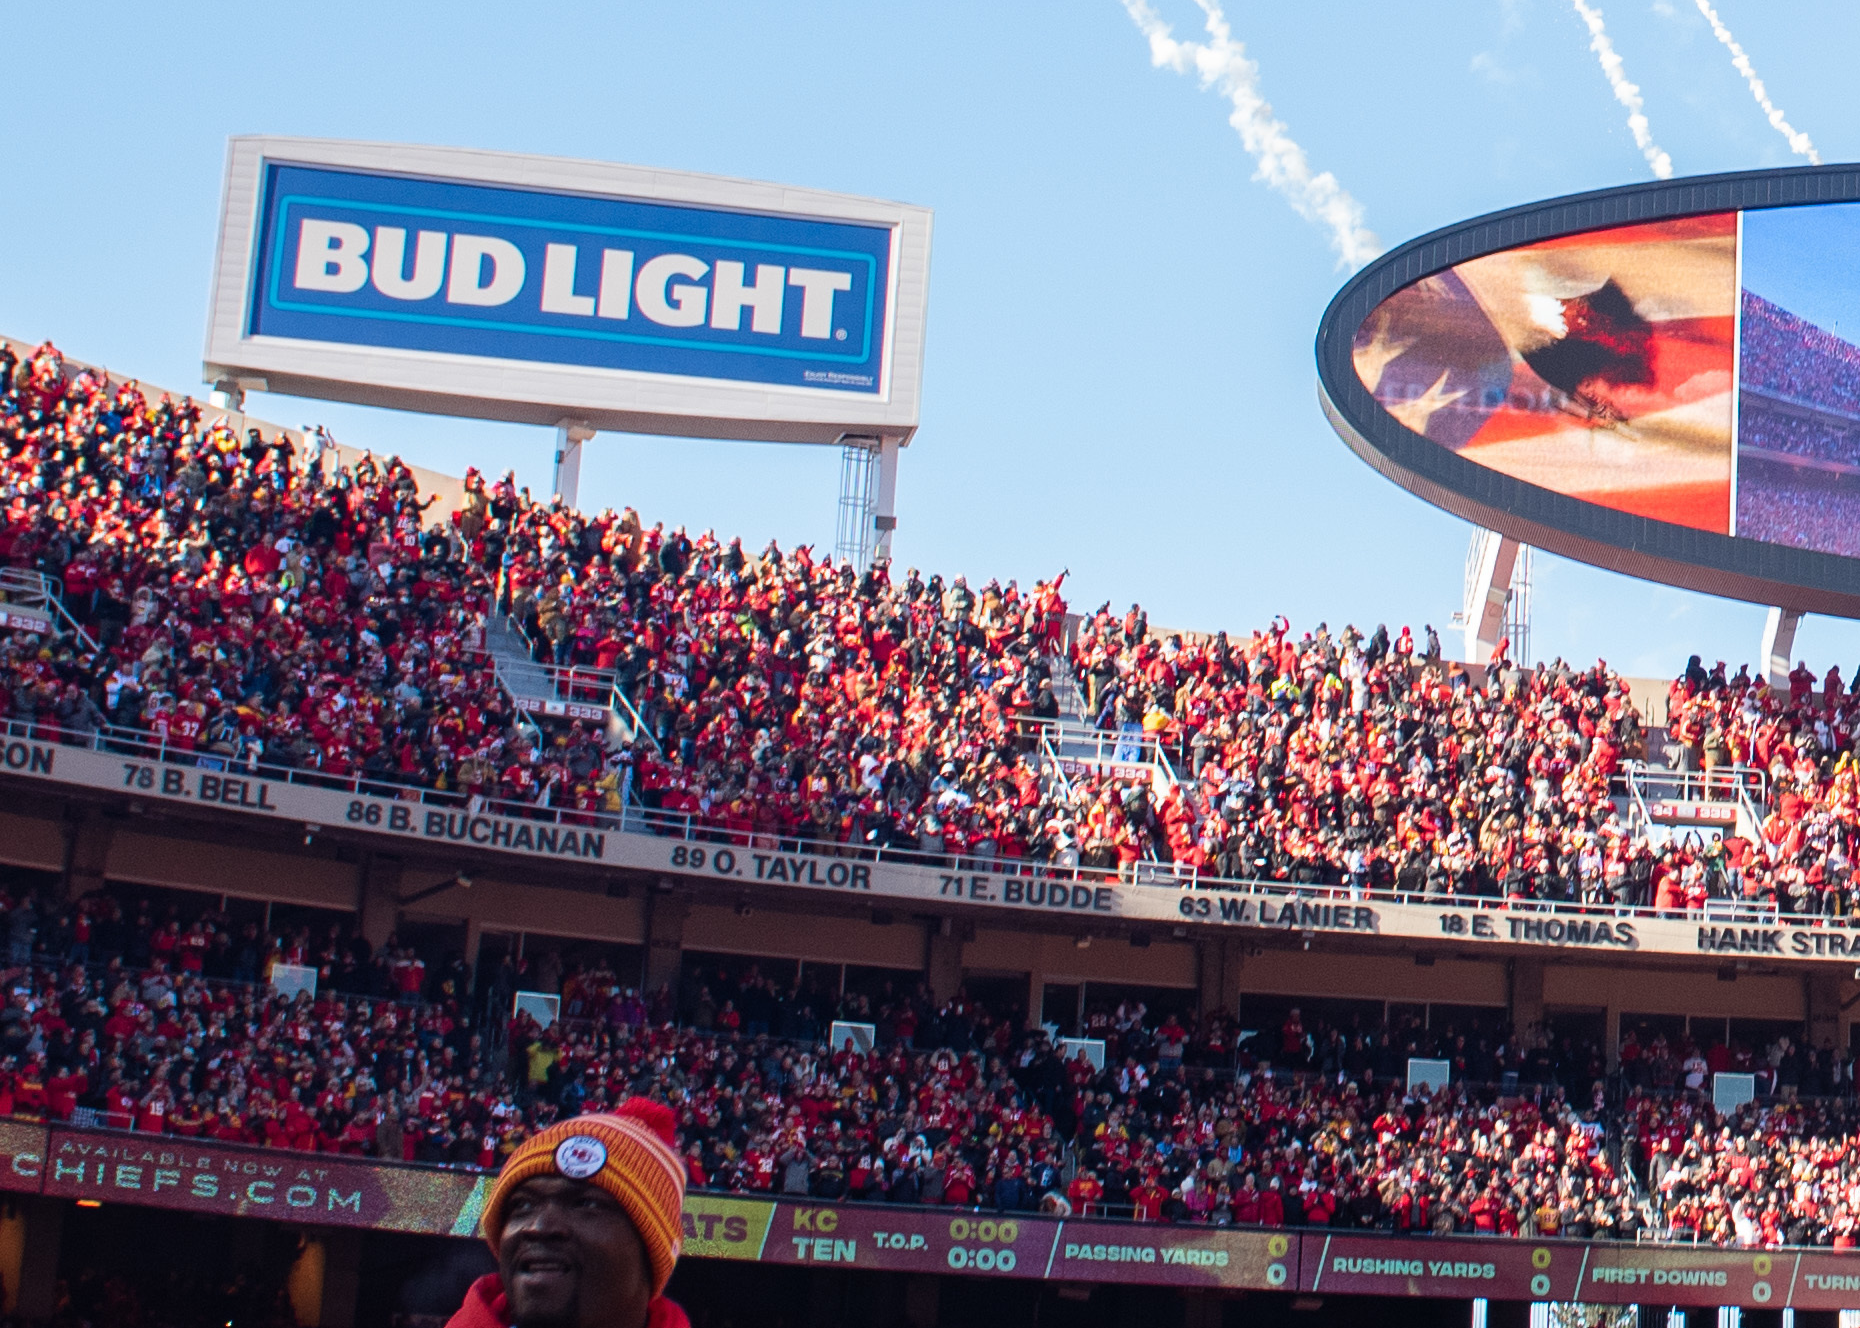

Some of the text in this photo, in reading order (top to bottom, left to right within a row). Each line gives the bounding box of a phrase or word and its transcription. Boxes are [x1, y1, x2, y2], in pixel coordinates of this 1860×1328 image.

[294, 218, 852, 340] BUD LIGHT
[0, 741, 55, 776] ON
[123, 763, 276, 811] 78 B. BELL
[345, 800, 605, 859] 86 B. BUCHANAN
[671, 844, 871, 890] 89 O. TAYLOR
[940, 873, 1113, 912] 71 E. BUDDE
[1179, 897, 1376, 931] 63 W. LANIER
[1440, 914, 1636, 948] 18 E. THOMAS
[1698, 926, 1784, 956] HANK
[59, 1139, 329, 1181] AVAILABLE NOW AT
[12, 1151, 362, 1214] CHIEFS.COM
[792, 1207, 1019, 1244] KC 0:00
[873, 1231, 928, 1252] T.O.P.
[792, 1236, 1017, 1272] TEN 0:00
[1065, 1243, 1230, 1268] PASSING YARDS
[1268, 1235, 1289, 1259] 0
[1532, 1248, 1552, 1270] 0
[1266, 1262, 1288, 1287] 0
[1333, 1256, 1496, 1280] RUSHING YARDS
[1592, 1267, 1727, 1288] FIRST DOWNS
[1752, 1254, 1772, 1277] 0
[1530, 1274, 1552, 1297] 0
[1751, 1281, 1772, 1304] 0
